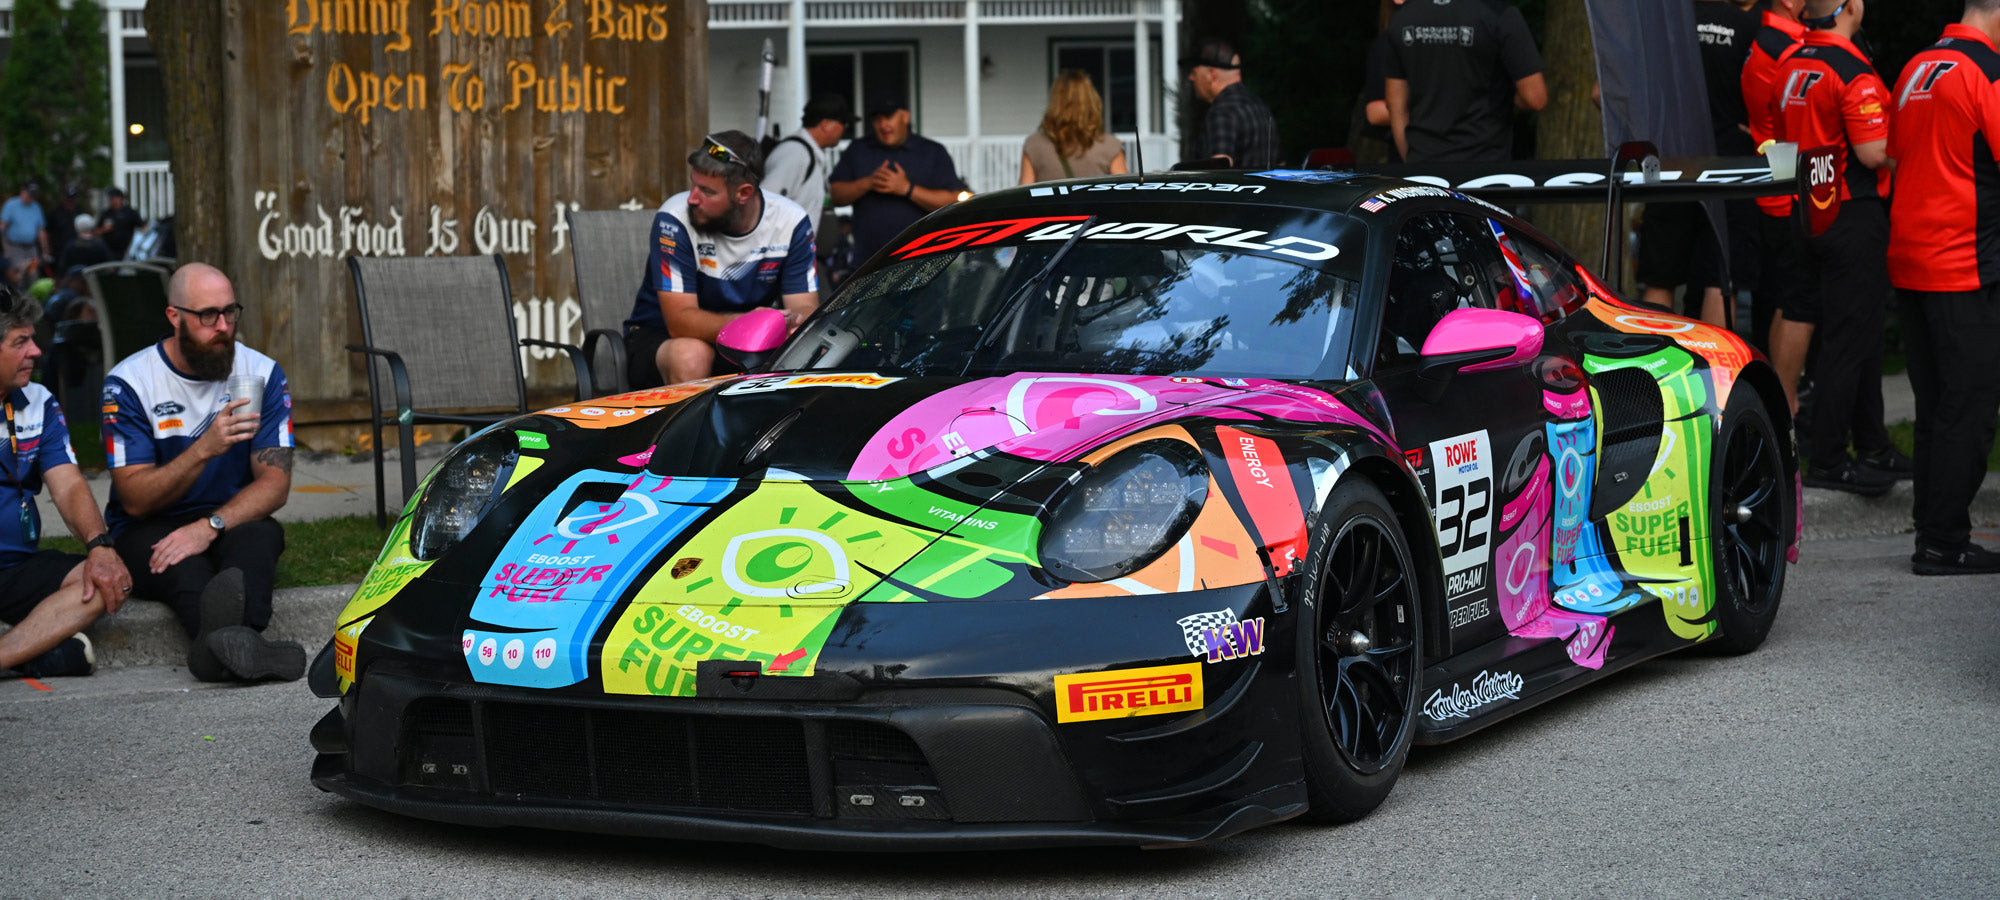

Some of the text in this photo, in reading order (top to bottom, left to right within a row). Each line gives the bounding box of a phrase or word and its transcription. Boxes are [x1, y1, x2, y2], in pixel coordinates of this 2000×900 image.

[285, 0, 411, 52] Dining
[429, 0, 531, 38] Room
[586, 0, 669, 41] Bars
[327, 60, 626, 126] Open To Public
[1810, 153, 1835, 187] aws
[1087, 183, 1267, 194] seaspan
[337, 205, 406, 260] Food
[425, 204, 459, 257] Is
[474, 204, 537, 256] Our
[1239, 436, 1274, 488] ENERGY
[1444, 439, 1478, 468] ROWE
[1458, 462, 1479, 475] MOTOR OIL
[1629, 494, 1673, 512] EBOOST
[928, 506, 999, 530] VITAMINS
[1440, 476, 1491, 559] 32
[1616, 500, 1690, 536] SUPER
[1556, 521, 1583, 546] SUPER
[1626, 531, 1681, 557] FUEL
[527, 553, 596, 566] EBOOST
[1556, 545, 1577, 566] FUEL
[494, 562, 613, 587] SUPER
[1447, 566, 1482, 597] PRO-AM
[356, 576, 403, 602] FUEL
[489, 583, 569, 603] FUEL
[676, 604, 761, 642] EBOOST
[482, 646, 493, 658] 5g
[507, 648, 518, 659] 10
[535, 648, 552, 659] 110
[1202, 616, 1265, 664] KW
[1068, 673, 1193, 713] PIRELLI
